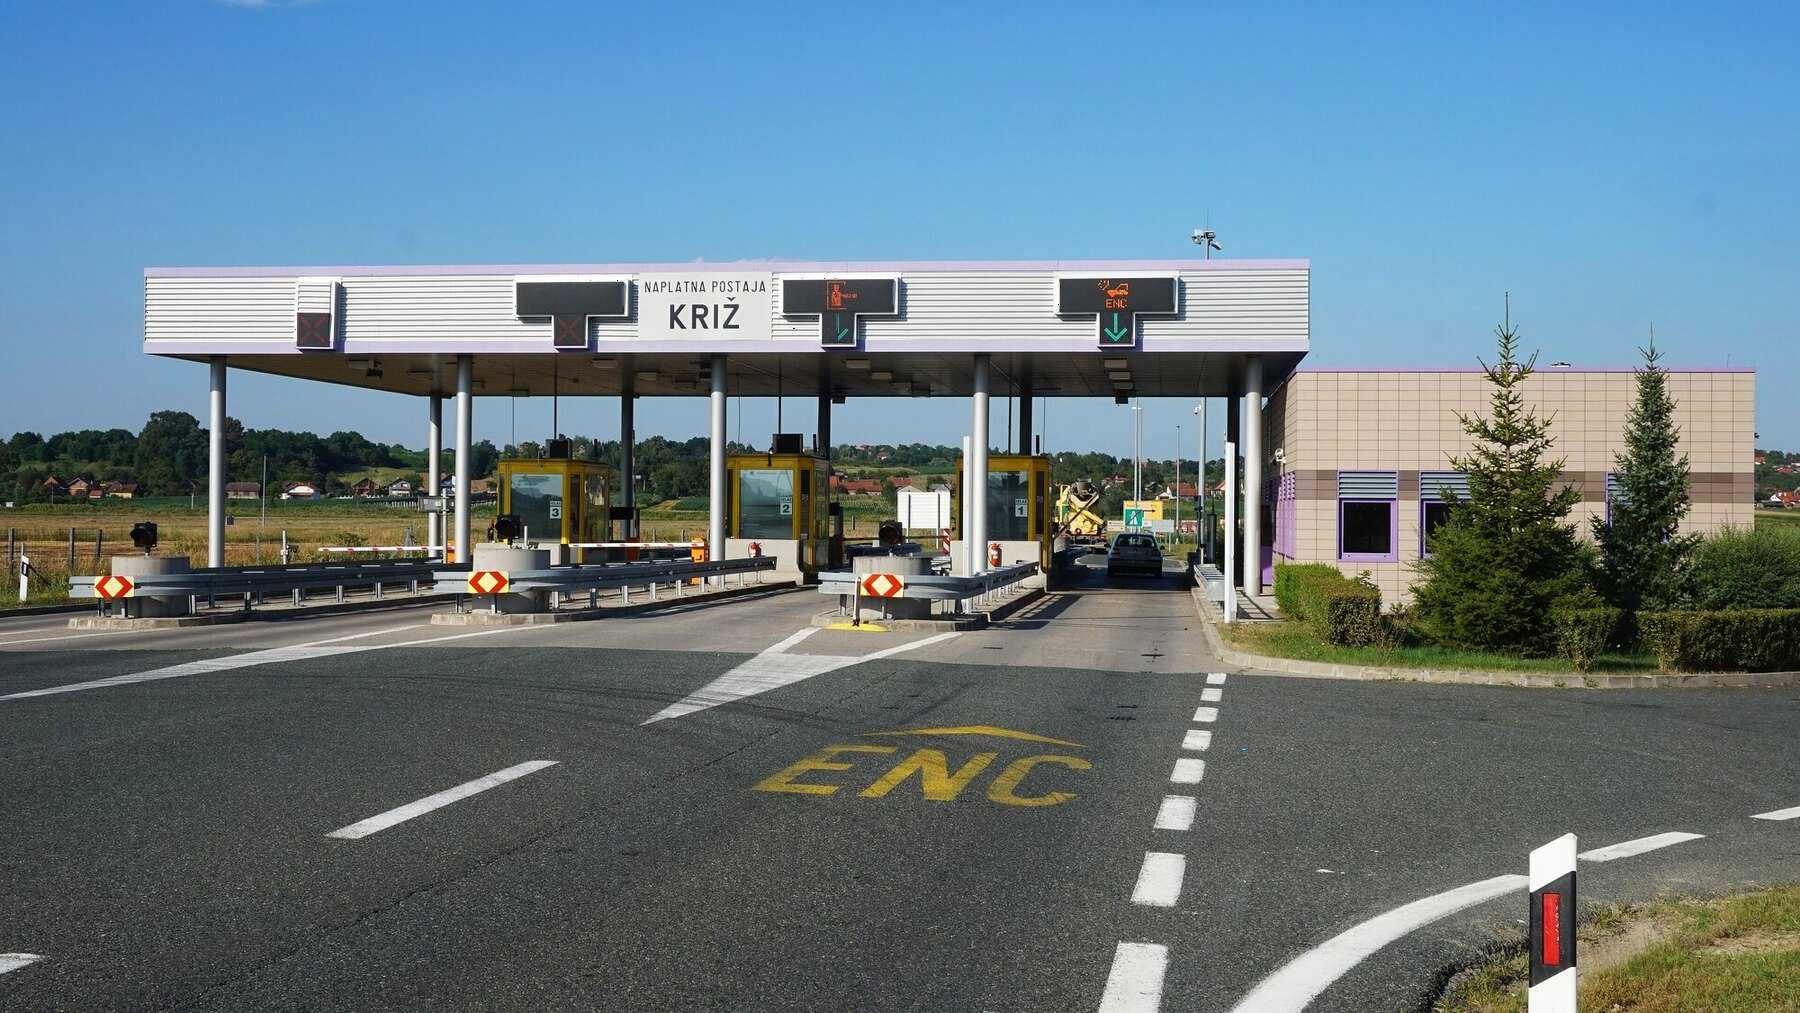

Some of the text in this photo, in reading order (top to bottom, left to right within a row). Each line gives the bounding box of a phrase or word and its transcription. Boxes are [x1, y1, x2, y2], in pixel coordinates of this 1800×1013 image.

[644, 280, 766, 293] NAPLATNA POSTAJA
[1105, 298, 1128, 309] ENC
[669, 296, 740, 330] KRIŽ
[551, 507, 560, 518] 3
[782, 503, 791, 514] 2
[1017, 505, 1024, 516] 1
[752, 744, 1093, 807] ENC
